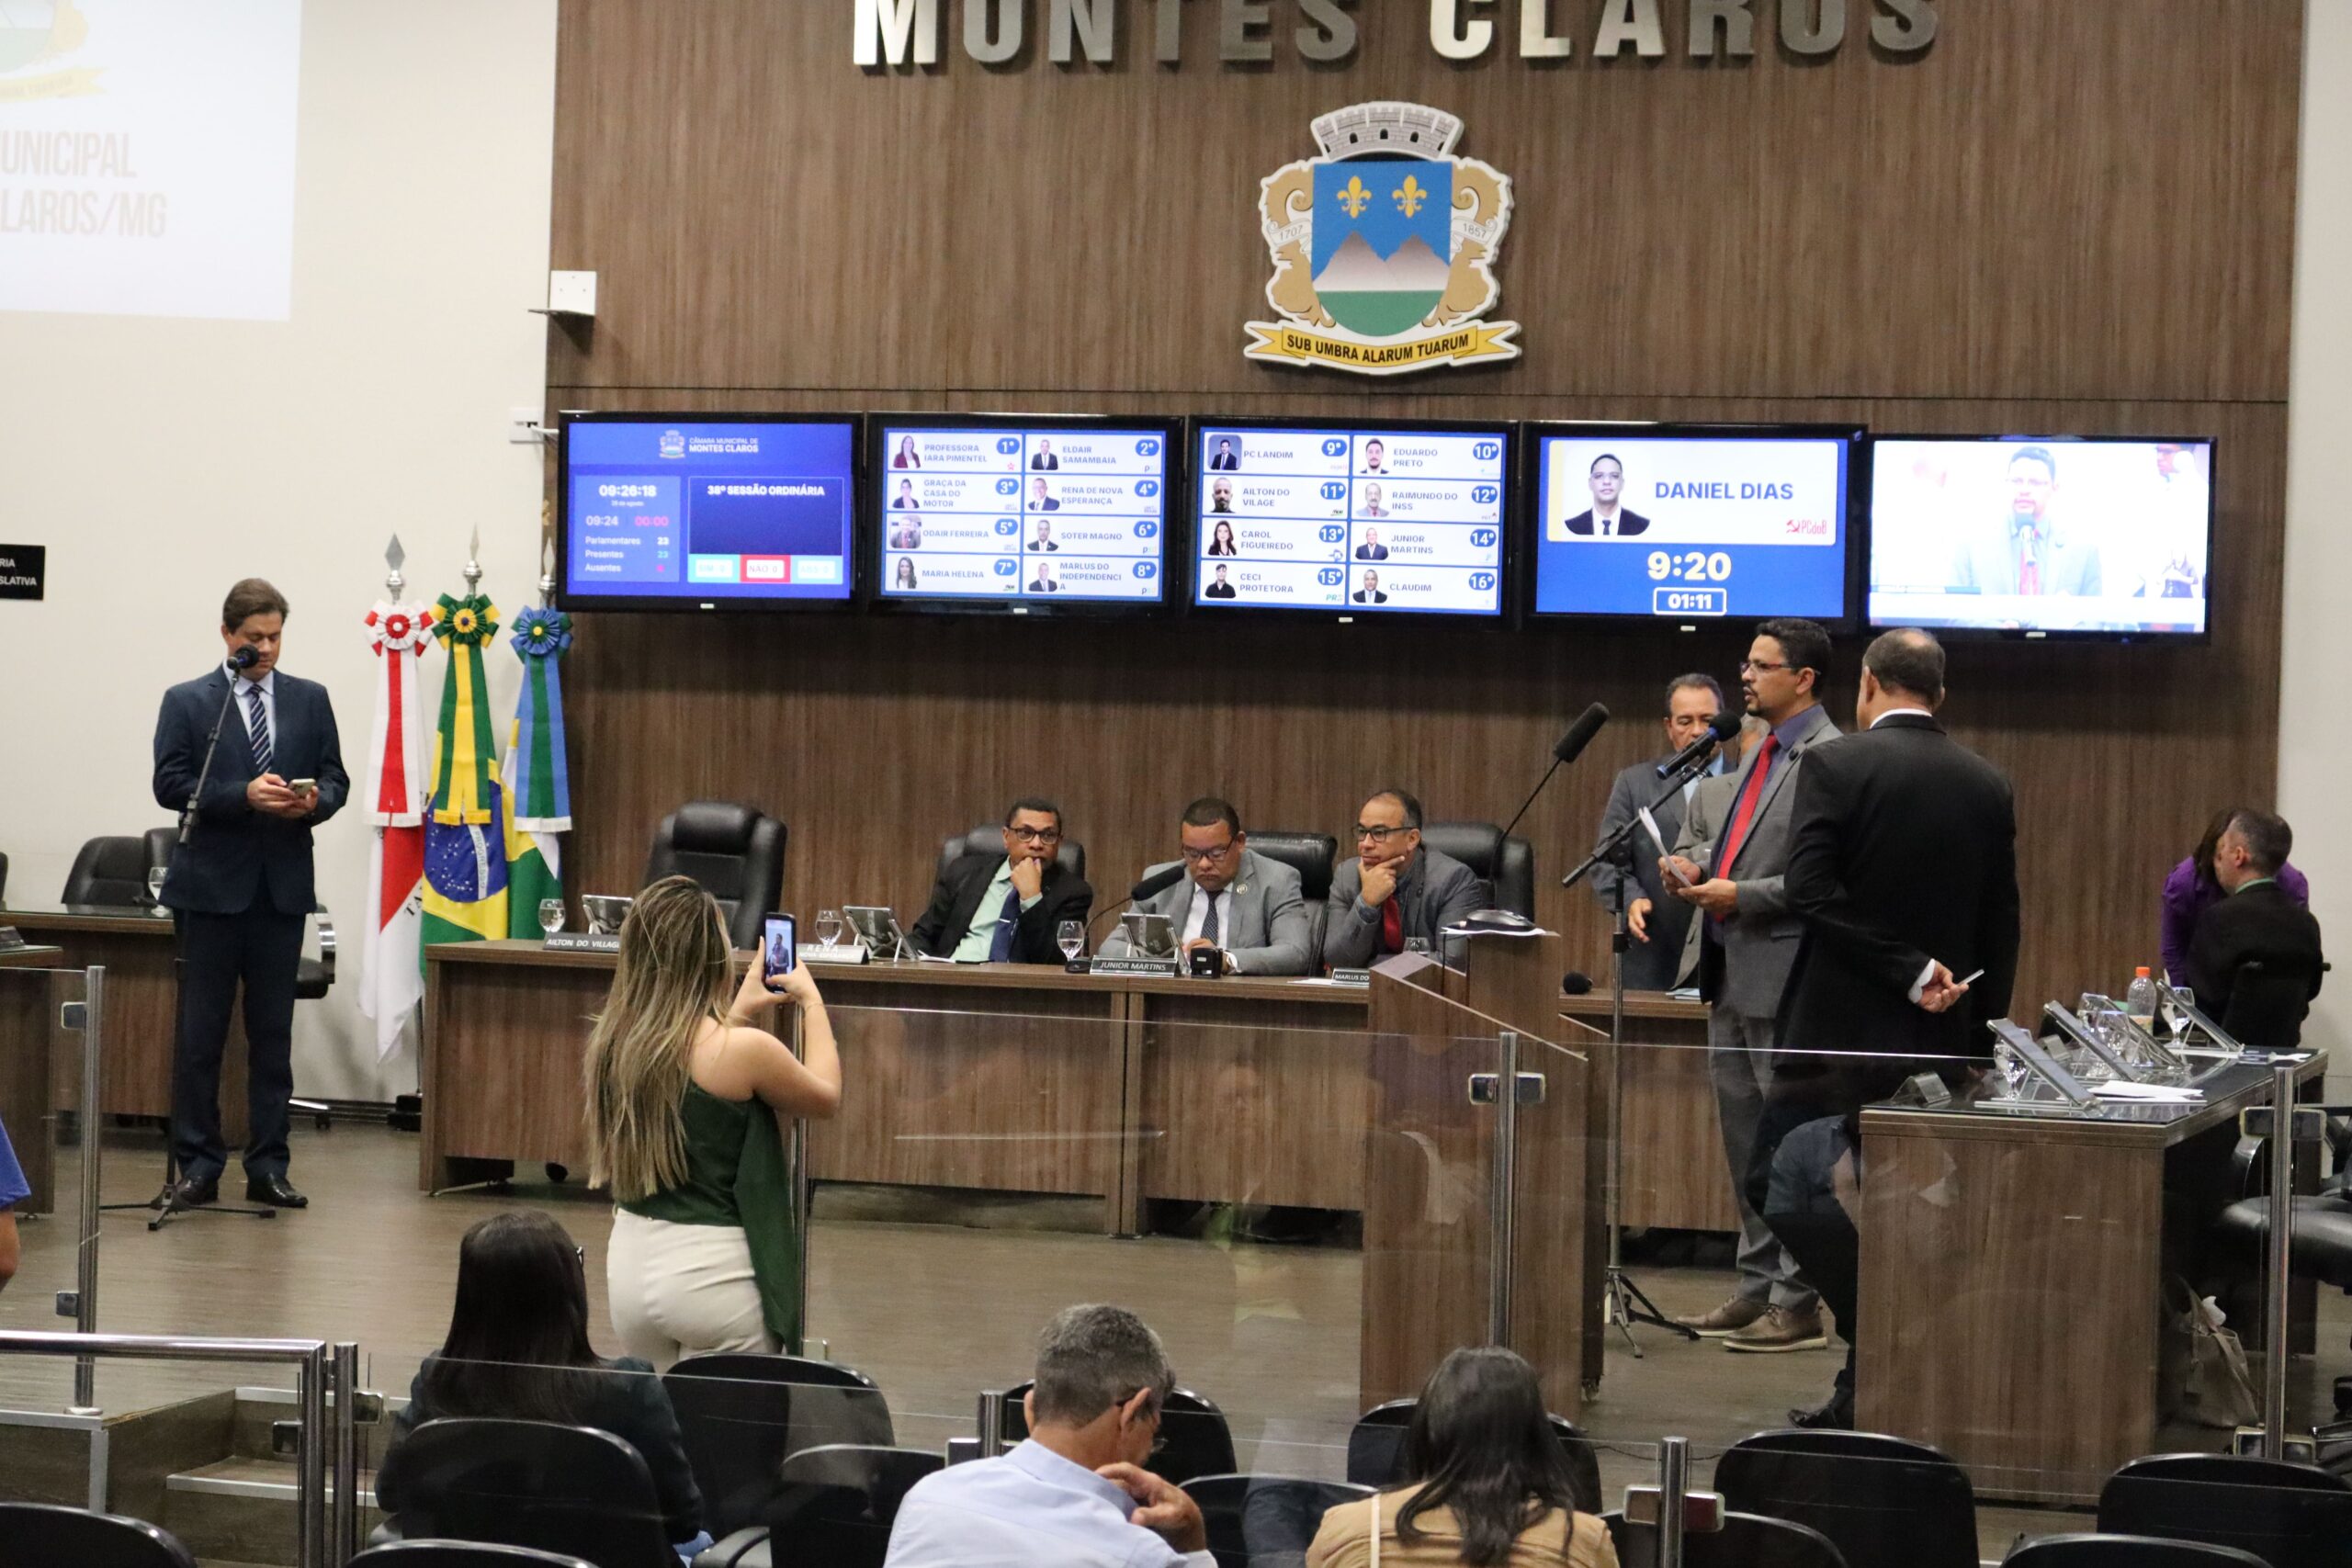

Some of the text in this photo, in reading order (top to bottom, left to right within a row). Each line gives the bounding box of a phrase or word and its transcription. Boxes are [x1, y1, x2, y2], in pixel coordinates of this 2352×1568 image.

[1279, 224, 1303, 242] 1707
[1463, 222, 1487, 240] 1857
[1287, 333, 1469, 363] SUB UMBRA ALARUM TUARUM
[689, 444, 759, 453] MONTES CLAROS
[1394, 448, 1438, 457] EDUARDO
[924, 479, 953, 488] GRAÇA
[599, 485, 657, 497] 09:26:18
[727, 483, 767, 495] SESSÃO
[768, 483, 825, 496] ORDINÁRIA
[1656, 482, 1793, 500] DANIEL DIAS
[1061, 497, 1113, 505] ESPERANÇA
[1243, 499, 1274, 507] VILAGE
[1392, 502, 1413, 511] INSS
[586, 515, 618, 526] 09:24
[1801, 520, 1827, 535] PCdoB
[1241, 530, 1272, 538] CAROL
[585, 536, 669, 546] Parlamentares 23
[1391, 535, 1425, 543] JUNIOR
[1240, 541, 1294, 550] FIGUEIREDO
[1390, 546, 1433, 554] MARTINS
[585, 549, 624, 558] Presentes
[584, 564, 621, 572] Ausentes
[1647, 551, 1732, 581] 9:20
[0, 575, 38, 586] SLATIVA
[1239, 584, 1294, 592] PROTETORA
[1389, 583, 1432, 592] CLAUDIM
[1668, 593, 1713, 610] 01:11
[807, 942, 839, 953] RENA
[1130, 963, 1166, 971] MARTINS
